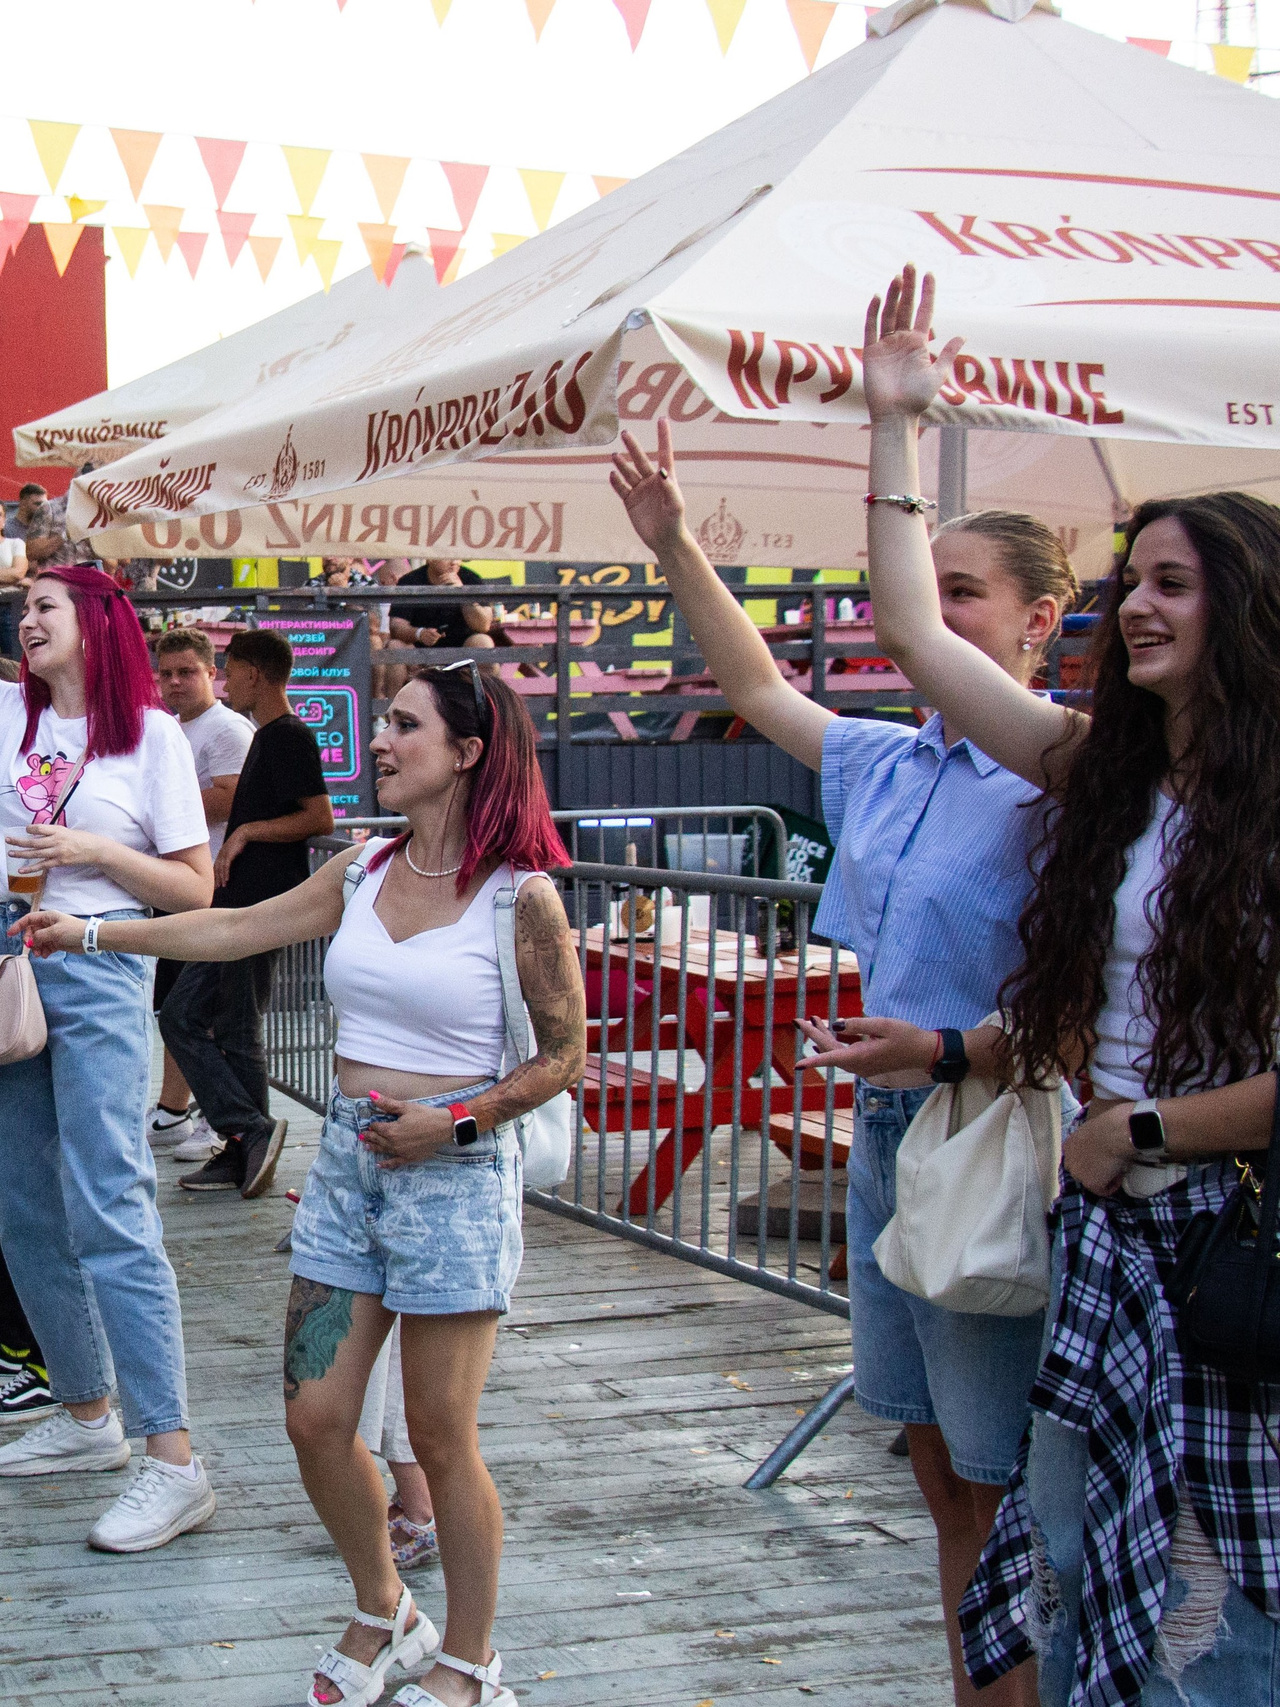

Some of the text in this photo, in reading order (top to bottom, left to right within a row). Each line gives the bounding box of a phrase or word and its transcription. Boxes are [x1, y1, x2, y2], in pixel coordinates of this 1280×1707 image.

[302, 459, 326, 481] 1581
[258, 618, 354, 630] ИНТЕРАКТИВНЫЙ
[287, 631, 326, 643] МУЗЕЙ
[292, 646, 337, 657] ДЕОИГР
[290, 666, 351, 678] ОВОЙ КЛУБ
